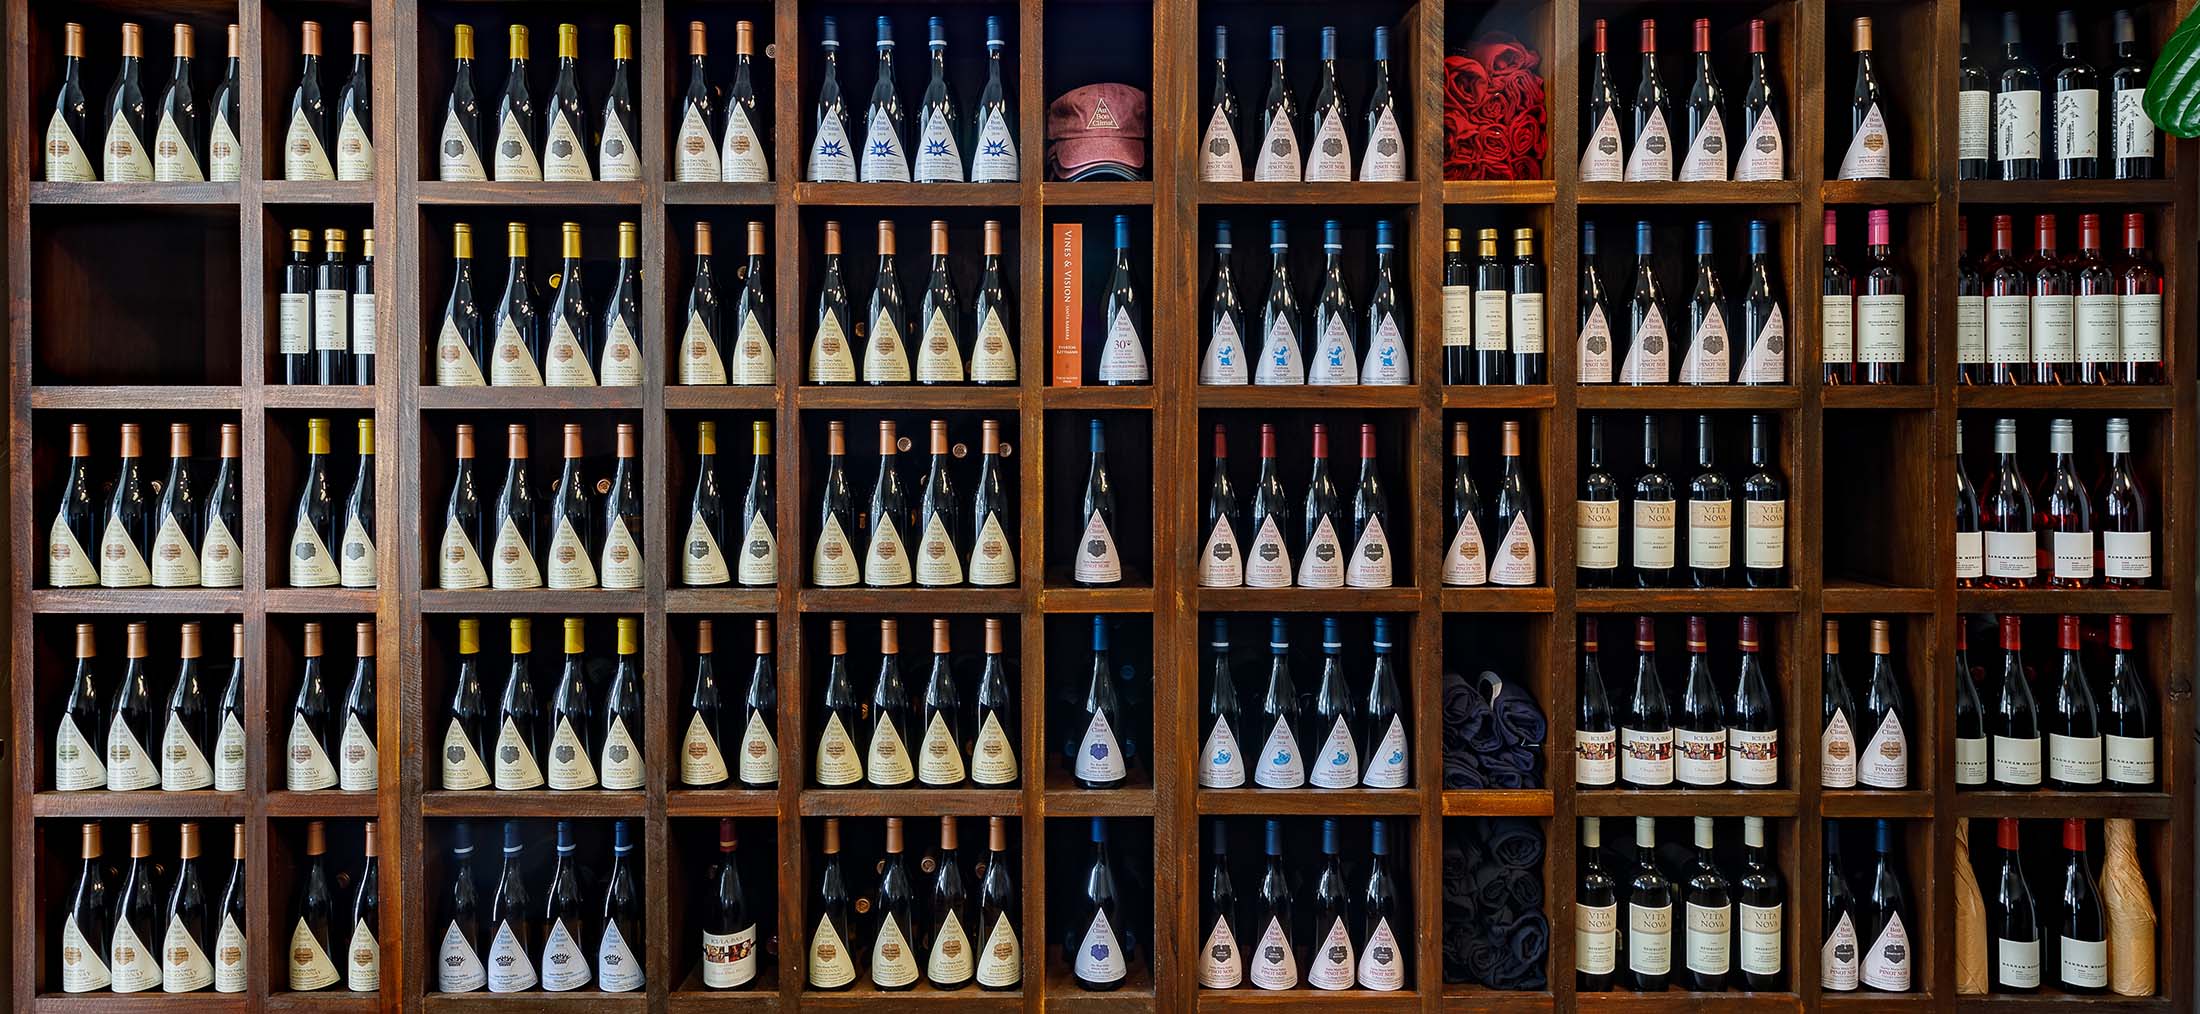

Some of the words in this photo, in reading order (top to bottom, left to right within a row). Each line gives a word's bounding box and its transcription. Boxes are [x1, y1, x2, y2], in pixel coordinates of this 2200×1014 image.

[1064, 230, 1073, 258] VINES
[1064, 270, 1073, 303] VISION
[1648, 506, 1672, 514] VITA
[1703, 506, 1727, 514] VITA
[1762, 506, 1783, 514] VITA
[1703, 514, 1728, 522] NOVA
[1762, 514, 1784, 522] NOVA
[1588, 911, 1610, 919] VITA
[1643, 912, 1666, 920] VITA
[1701, 911, 1724, 920] VITA
[1755, 911, 1777, 920] VITA
[1588, 920, 1611, 928] NOVA
[1643, 920, 1667, 928] NOVA
[1701, 920, 1725, 928] NOVA
[1755, 920, 1778, 928] NOVA
